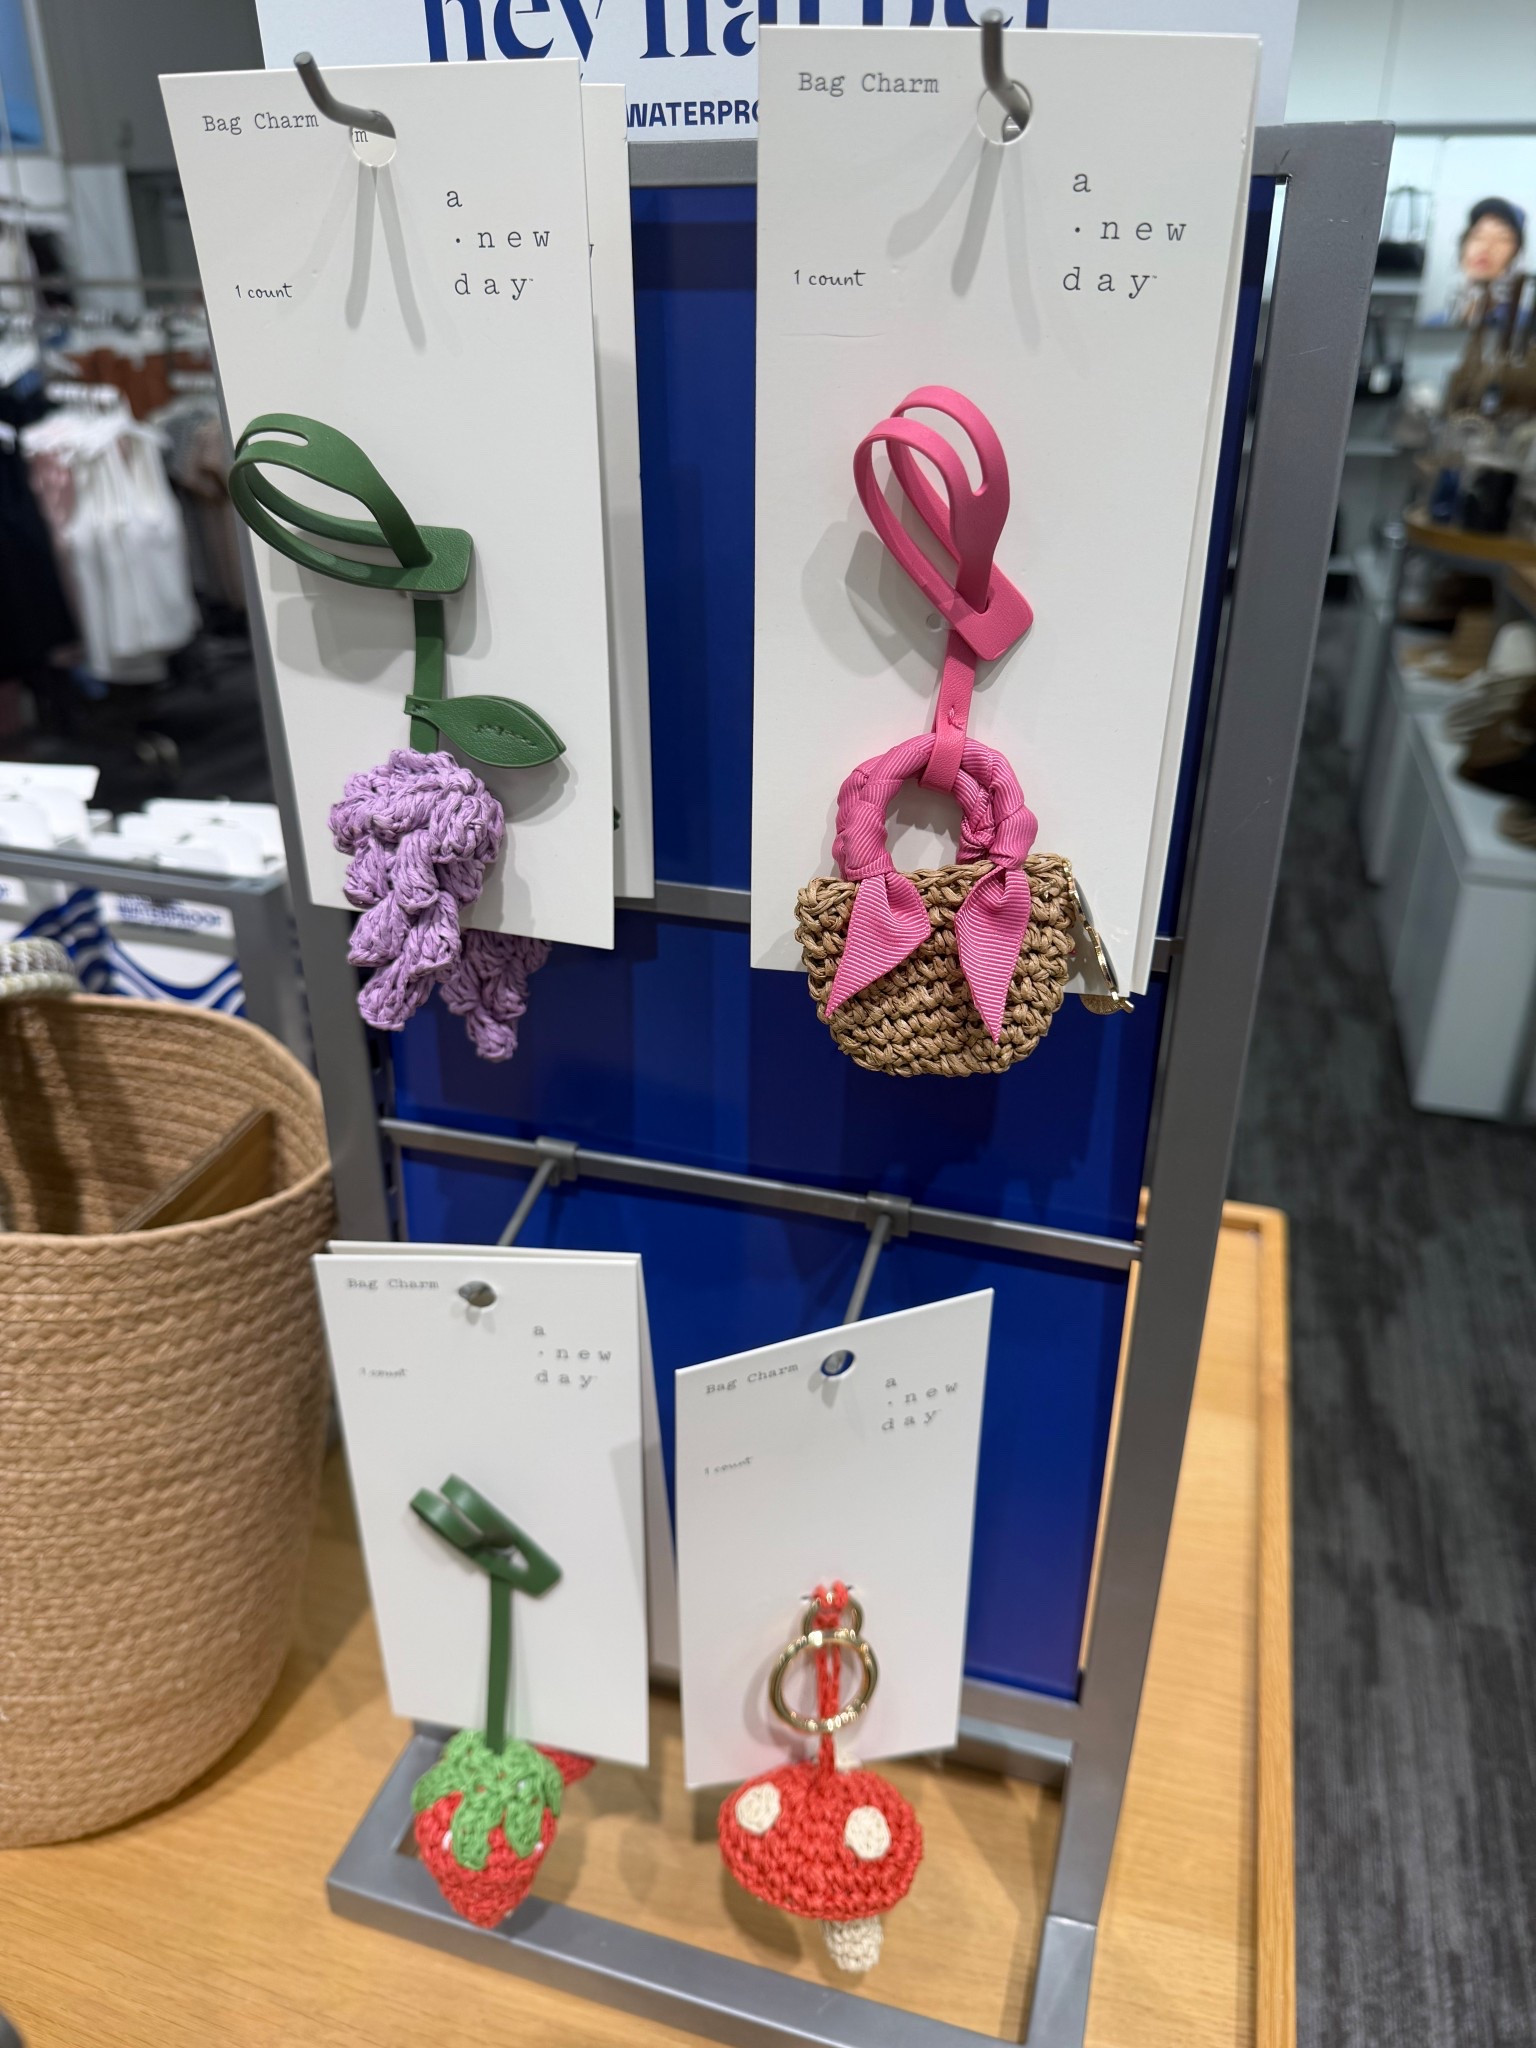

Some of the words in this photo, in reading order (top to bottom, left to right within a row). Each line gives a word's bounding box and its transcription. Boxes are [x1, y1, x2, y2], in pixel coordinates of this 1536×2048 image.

[797, 72, 845, 97] Bag
[861, 73, 939, 93] Charm
[202, 115, 242, 135] Bag
[254, 112, 319, 129] Charm
[1072, 173, 1091, 193] a
[446, 190, 463, 208] a
[794, 269, 800, 285] 1
[808, 269, 866, 287] count
[235, 285, 242, 298] 1
[247, 282, 293, 299] count
[347, 1277, 377, 1290] Bag
[388, 1278, 440, 1289] Charm
[705, 1379, 738, 1395] Bag
[746, 1362, 799, 1384] Charm
